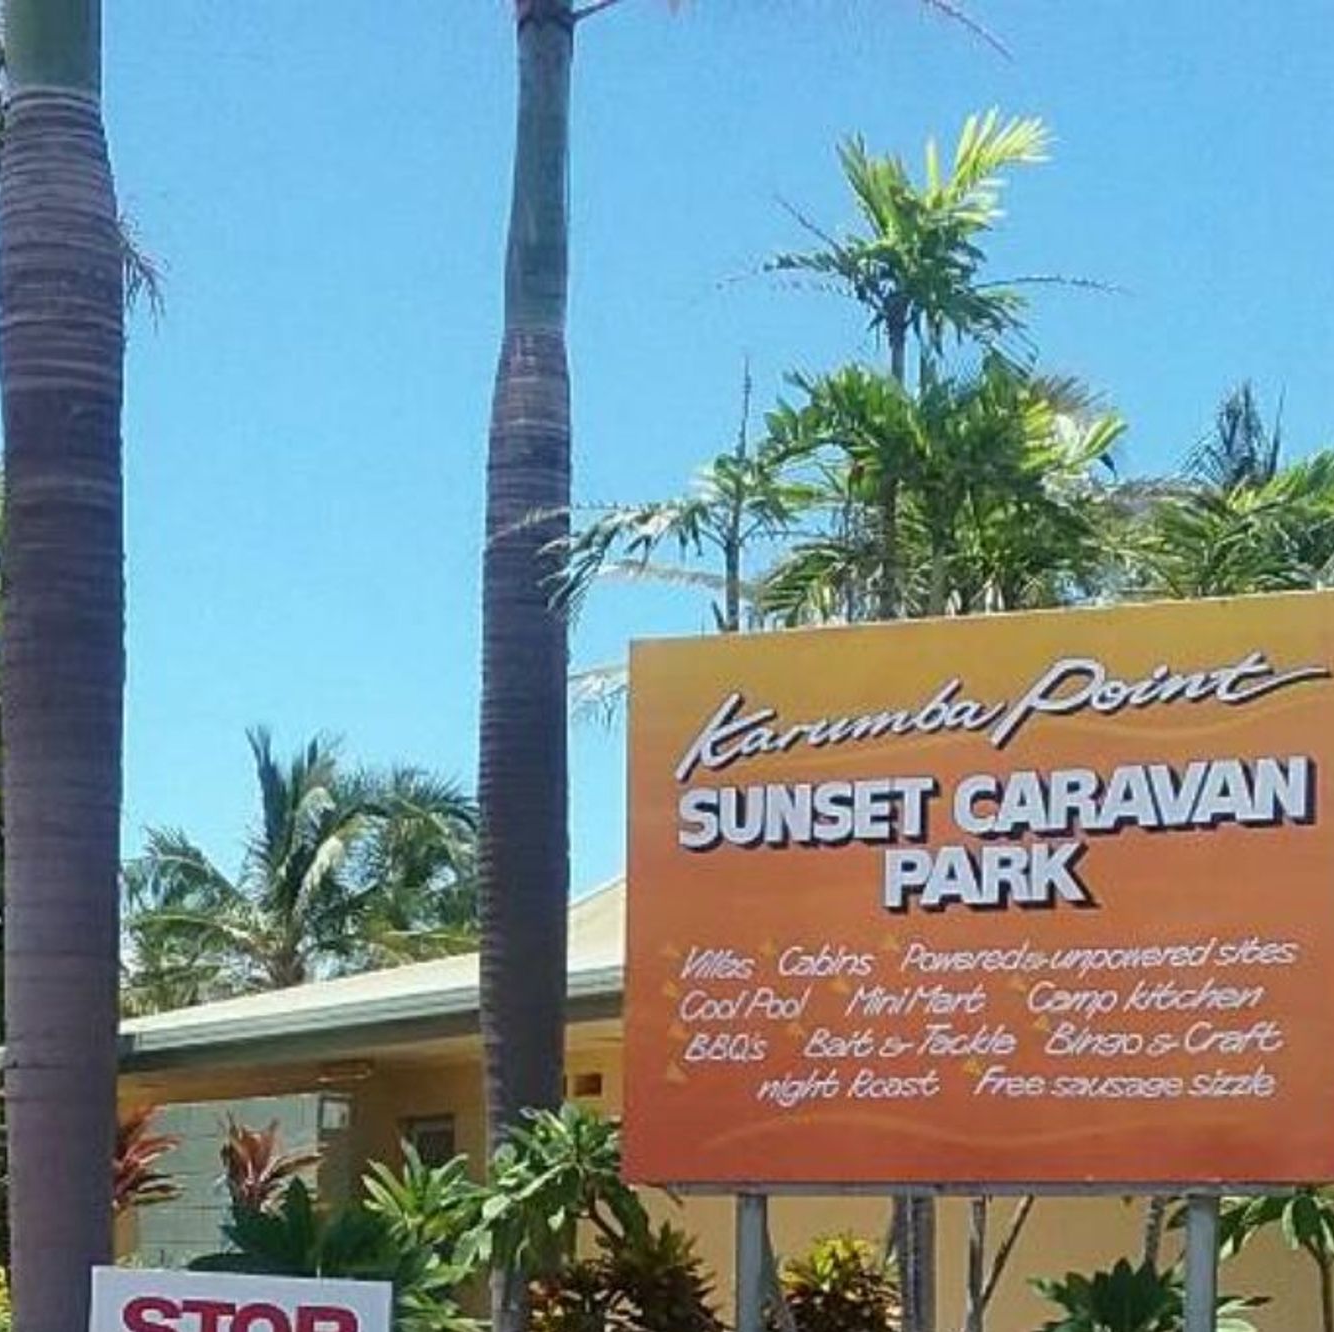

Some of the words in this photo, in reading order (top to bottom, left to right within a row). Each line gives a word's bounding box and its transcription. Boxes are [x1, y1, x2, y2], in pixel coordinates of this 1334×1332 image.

[675, 678, 1000, 781] Karumba
[992, 652, 1333, 748] Point
[678, 777, 937, 852] SUNSET
[952, 756, 1313, 838] CARAVAN
[884, 841, 1092, 908] PARK
[778, 944, 874, 977] Cabins
[901, 940, 1030, 973] Powered
[1049, 937, 1217, 979] unpowered
[1214, 936, 1299, 965] sites
[680, 990, 748, 1022] Cool
[744, 984, 813, 1019] Pool
[1027, 980, 1118, 1019] Camp
[1123, 978, 1265, 1011] kitchen
[803, 1026, 876, 1058] Bait
[878, 1034, 915, 1058] &
[919, 1022, 1017, 1056] Tackle
[1044, 1021, 1143, 1056] Bingo
[1146, 1033, 1180, 1056] &
[1184, 1020, 1285, 1054] Craft
[757, 1067, 840, 1107] night
[847, 1067, 941, 1098] Roast
[973, 1064, 1046, 1096] Free
[1050, 1074, 1184, 1099] sausage
[1188, 1064, 1276, 1098] sizzle
